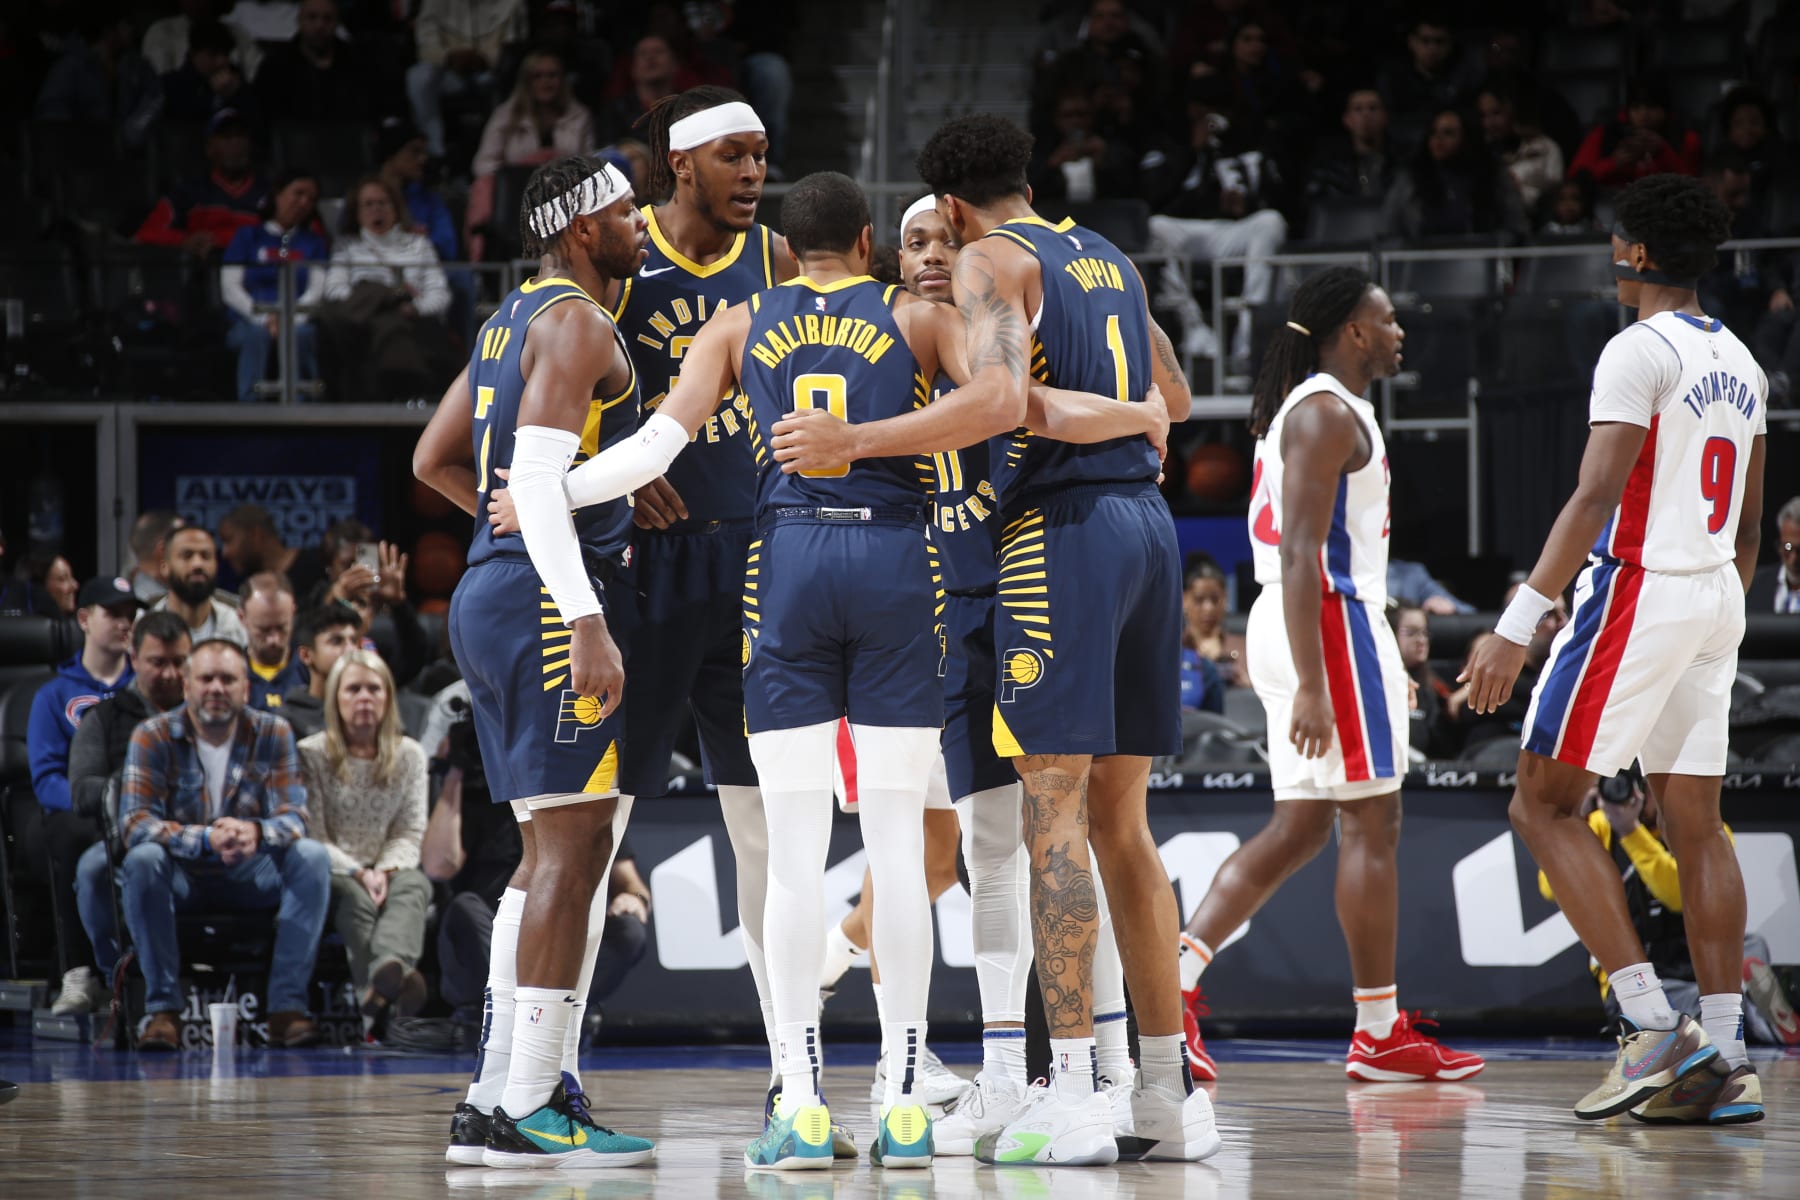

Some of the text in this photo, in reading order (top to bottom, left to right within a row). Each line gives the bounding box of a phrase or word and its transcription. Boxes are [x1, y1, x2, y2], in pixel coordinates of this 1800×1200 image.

[1064, 257, 1125, 293] TOPPIN
[750, 314, 896, 370] HALIBURTON
[1105, 314, 1129, 402] 1
[1683, 370, 1757, 421] THOMPSON
[933, 478, 998, 533] CERS
[1700, 436, 1737, 535] 9
